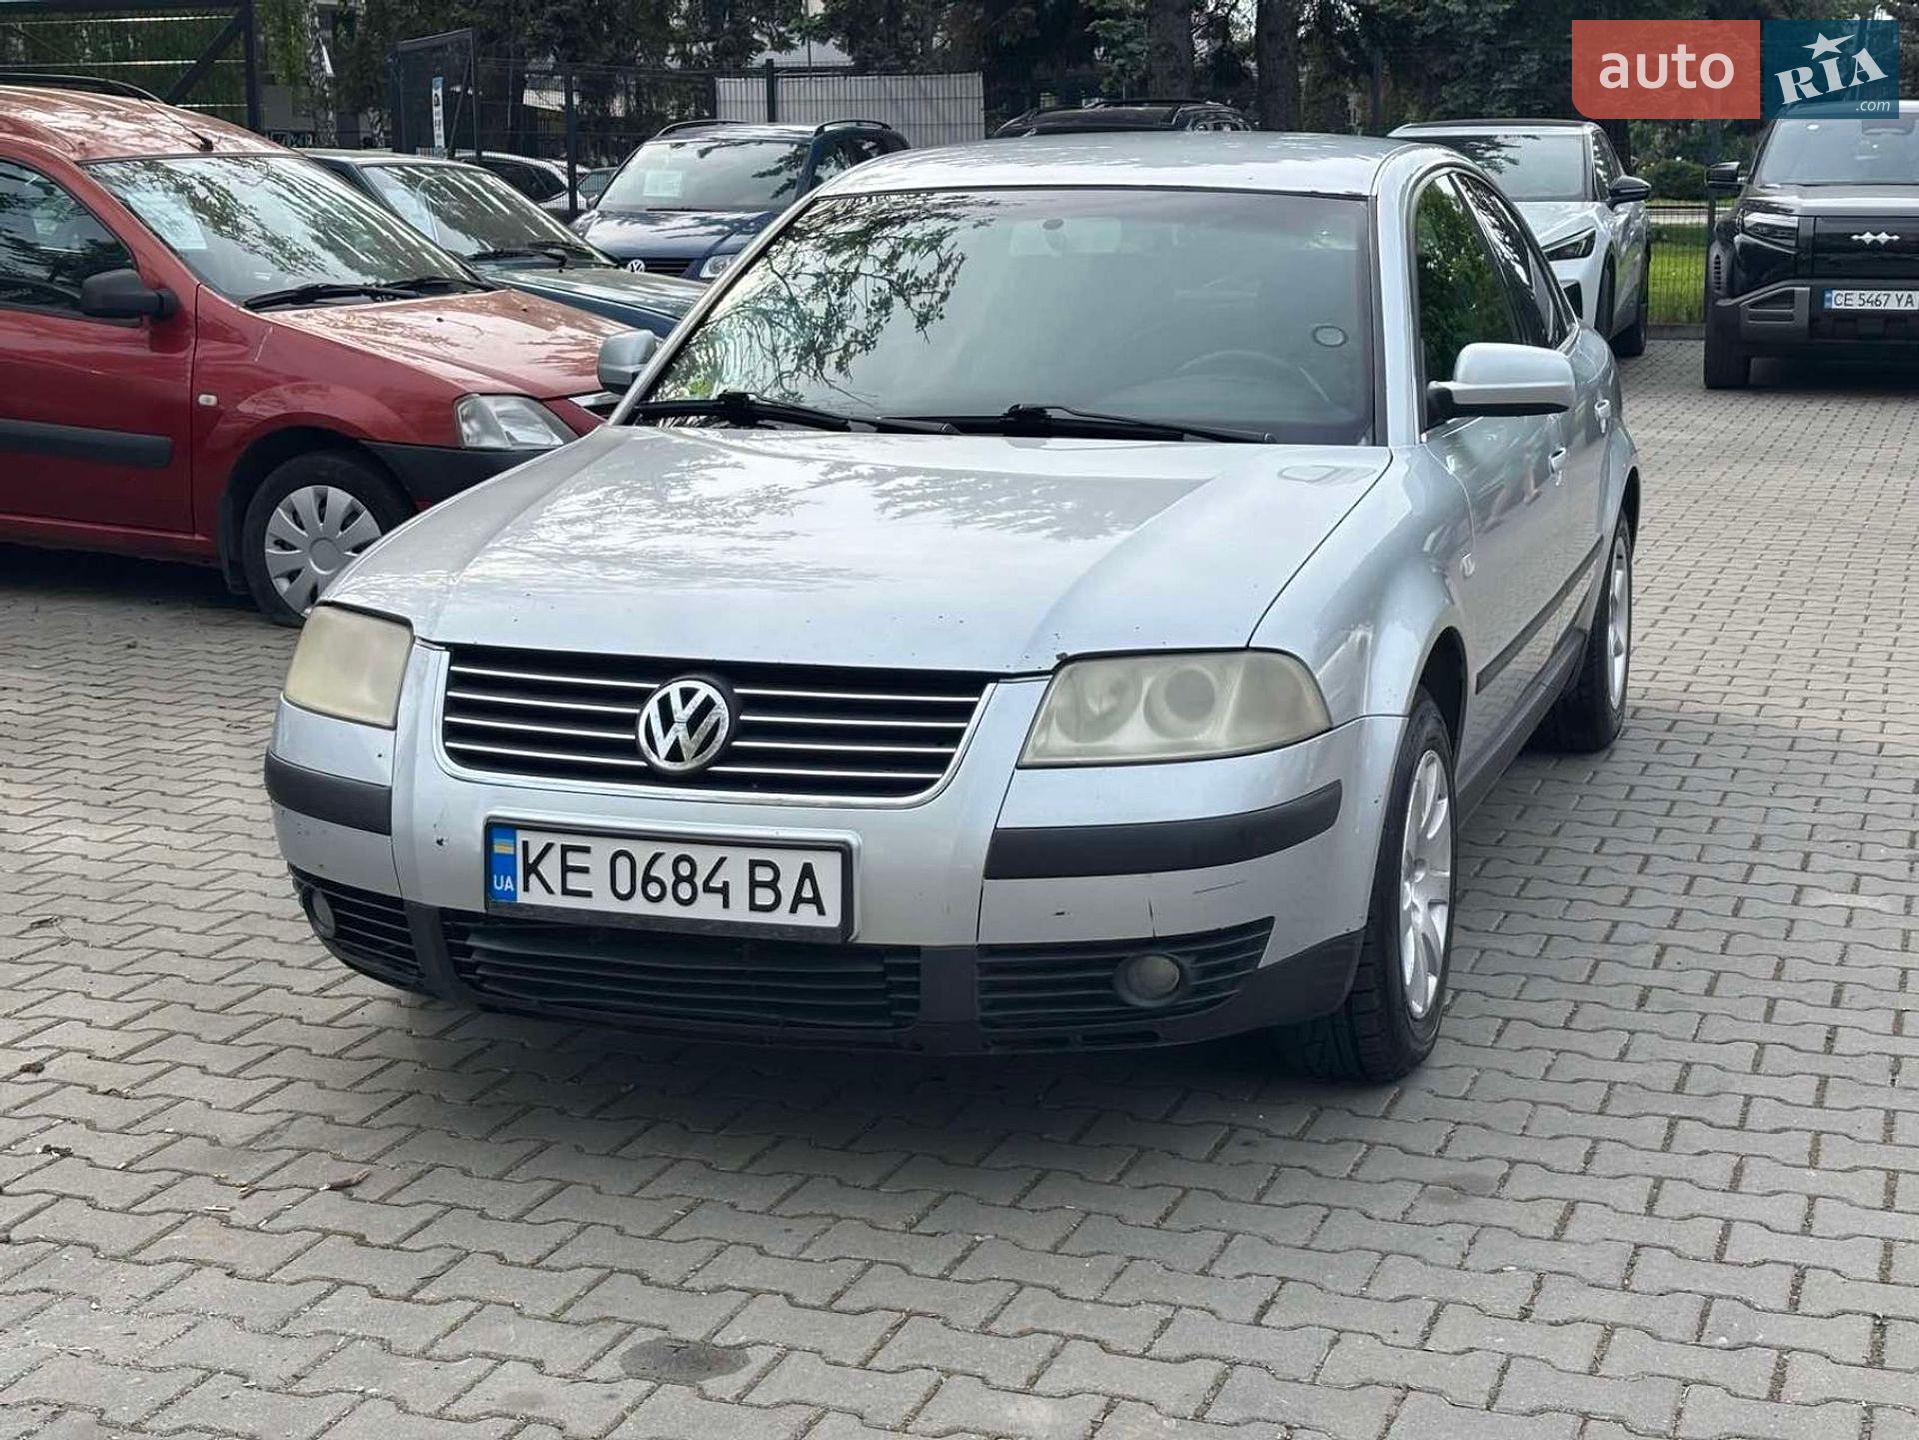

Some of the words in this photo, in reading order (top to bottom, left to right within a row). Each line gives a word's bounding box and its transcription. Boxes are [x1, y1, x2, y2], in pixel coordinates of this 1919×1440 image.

[1834, 293, 1854, 307] CE
[1858, 293, 1891, 307] 5467
[1895, 293, 1915, 307] YA
[639, 681, 729, 770] VW
[493, 874, 515, 893] UA
[521, 839, 593, 899] KE
[609, 848, 731, 910] 0684
[748, 858, 827, 917] BA
